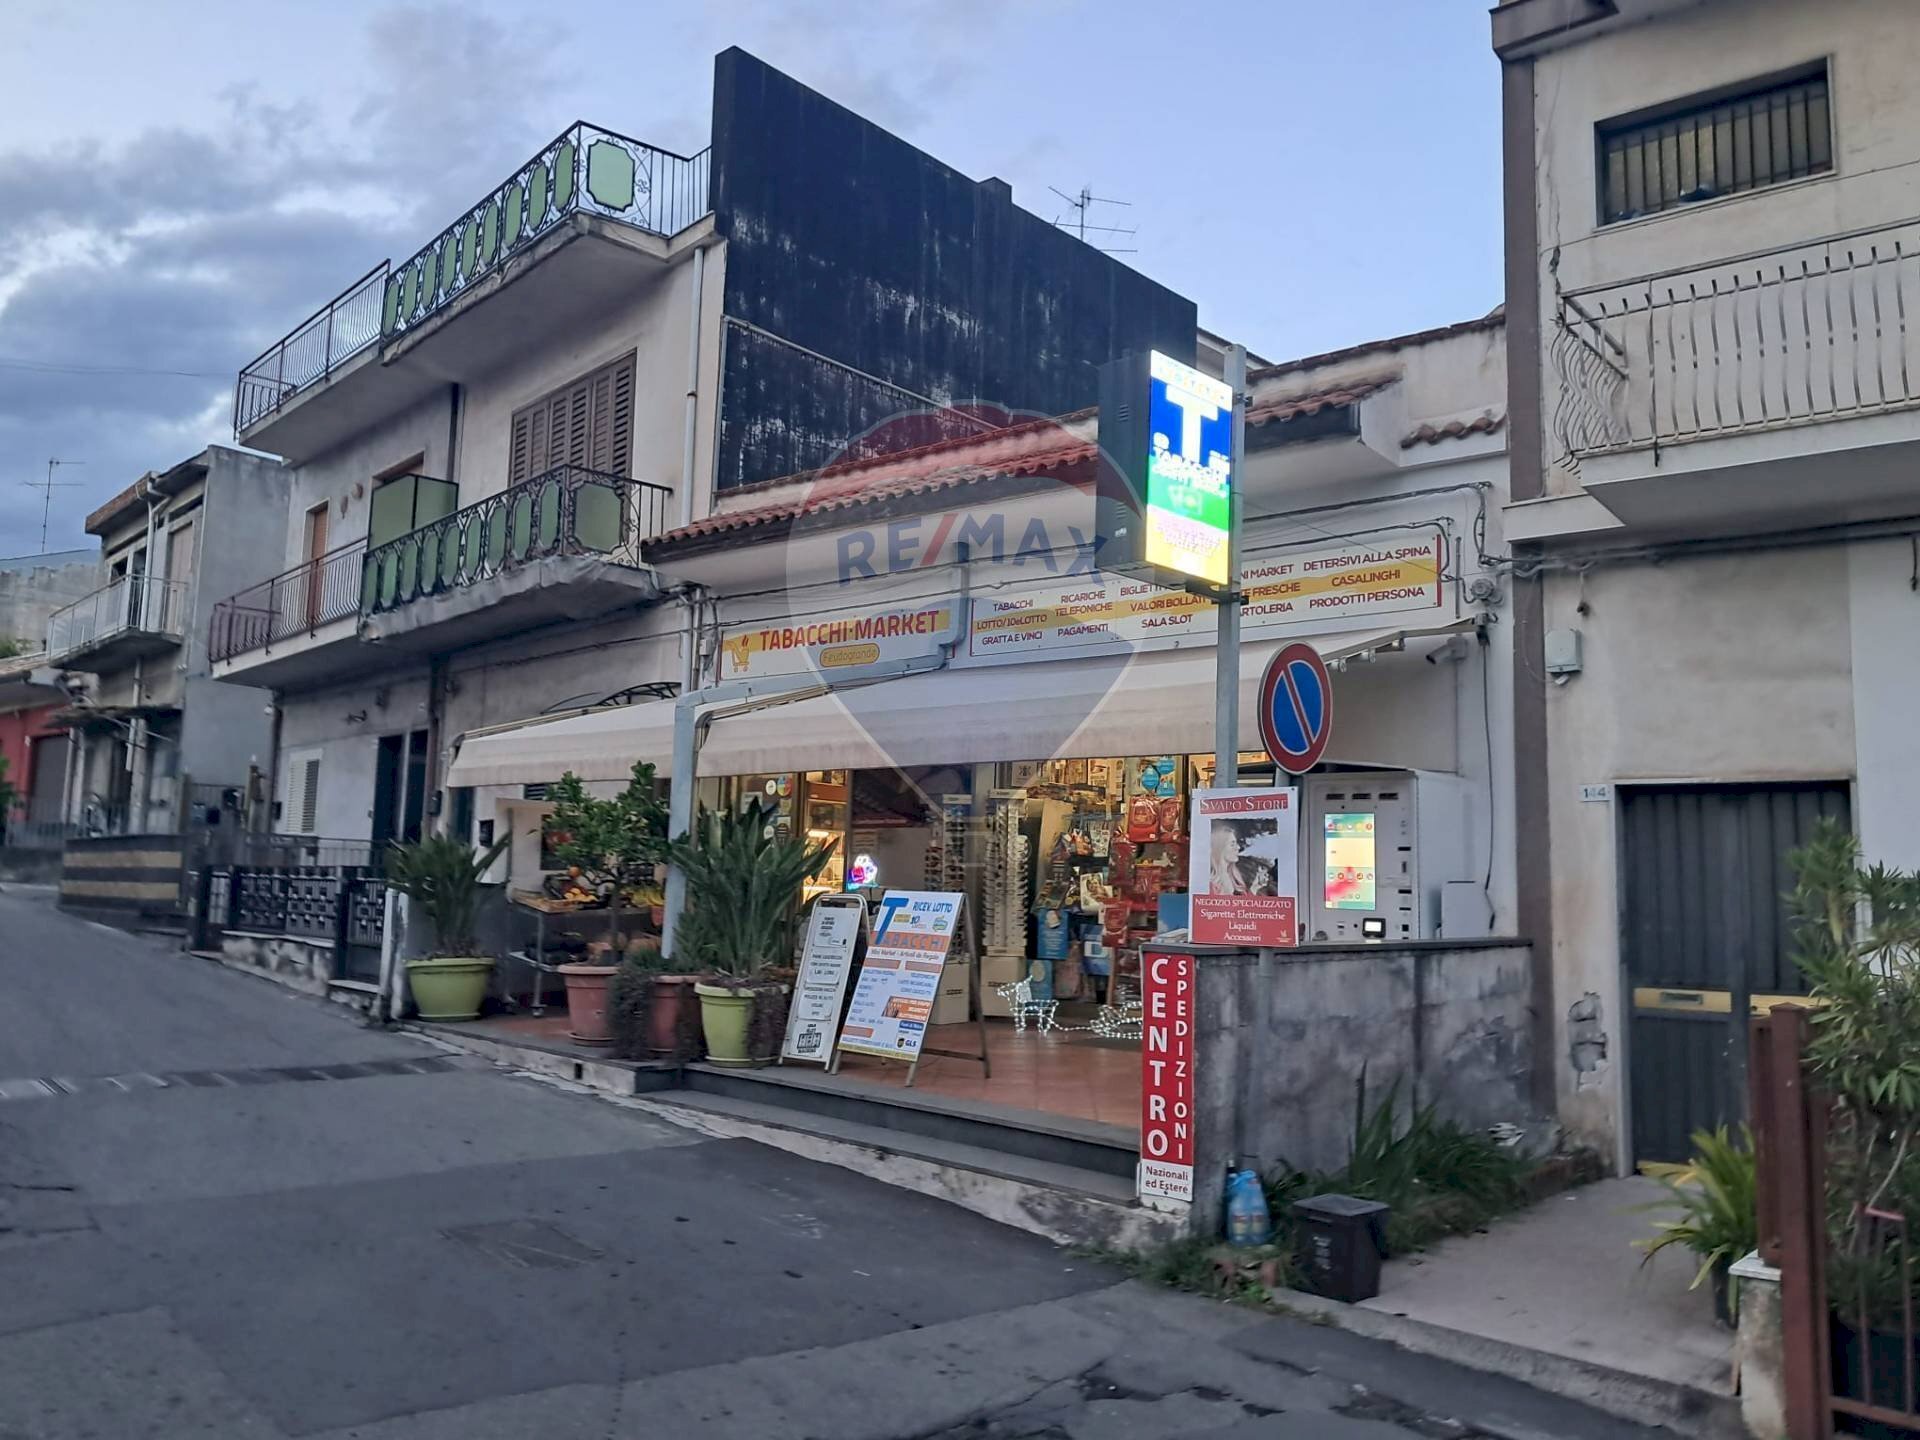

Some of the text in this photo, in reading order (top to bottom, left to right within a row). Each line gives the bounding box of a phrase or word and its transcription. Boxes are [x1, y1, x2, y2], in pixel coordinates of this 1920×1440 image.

[1303, 545, 1431, 572] DETERSIVI ALLA SPINA
[1250, 564, 1294, 579] MARKET
[1331, 570, 1401, 587] CASALINGHI
[1253, 582, 1301, 597] FRESCHE
[1061, 590, 1106, 604] RICARICHE
[1130, 595, 1206, 612] VALORI BOLLATI
[1309, 587, 1425, 608] PRODOTTI PERSONA
[993, 600, 1034, 612] TABACCHI
[1055, 602, 1113, 617] TELEFONICHE
[1141, 614, 1193, 628] SALA SLOT
[1057, 624, 1109, 637] PAGAMENTI
[982, 631, 1043, 645] GRATTA E VINCI
[1201, 797, 1287, 811] SVAPO STORE
[932, 903, 953, 913] LOTTO
[1195, 899, 1292, 909] NEGOZIO SPECIALIZZATO
[1201, 909, 1286, 920] Sigarette Elettroniche
[1228, 921, 1257, 932] Liquidi
[1224, 932, 1261, 942] Accessori
[1147, 957, 1169, 1157] CENTRO
[1173, 959, 1188, 1160] SPEDIZIONI
[1146, 1165, 1188, 1182] Nazionali
[1145, 1179, 1189, 1195] ed Estere
